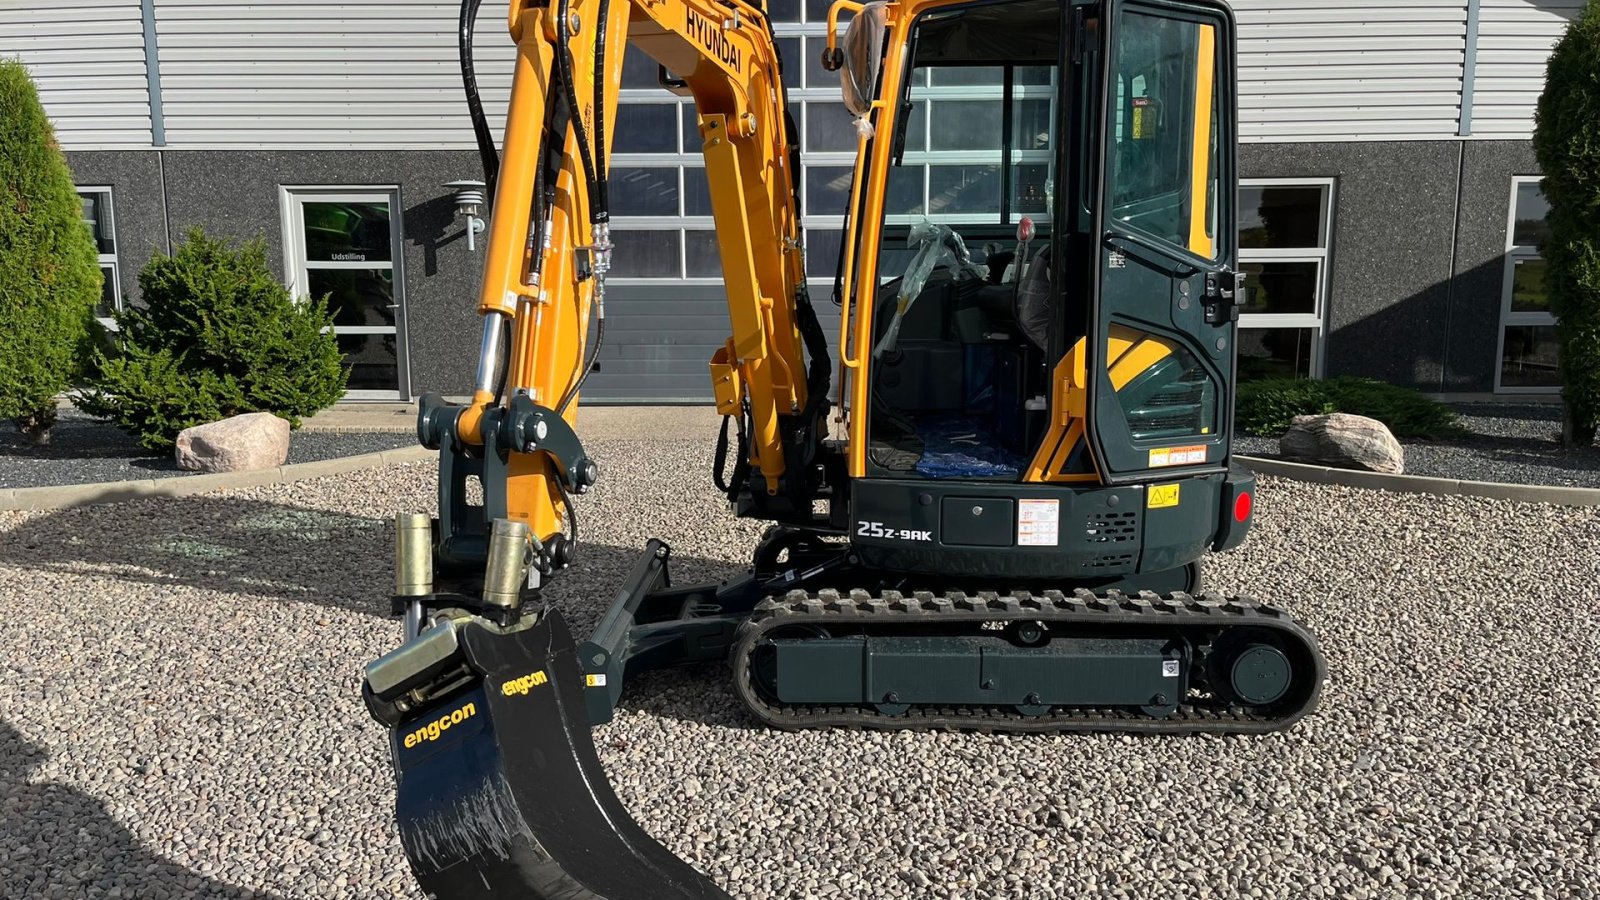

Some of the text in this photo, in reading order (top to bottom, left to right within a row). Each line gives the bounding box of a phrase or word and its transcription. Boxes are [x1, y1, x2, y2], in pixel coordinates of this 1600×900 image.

[686, 5, 741, 74] HYUNDAI
[331, 252, 366, 262] Udstilling
[501, 670, 548, 696] engcon
[404, 702, 476, 749] engcon
